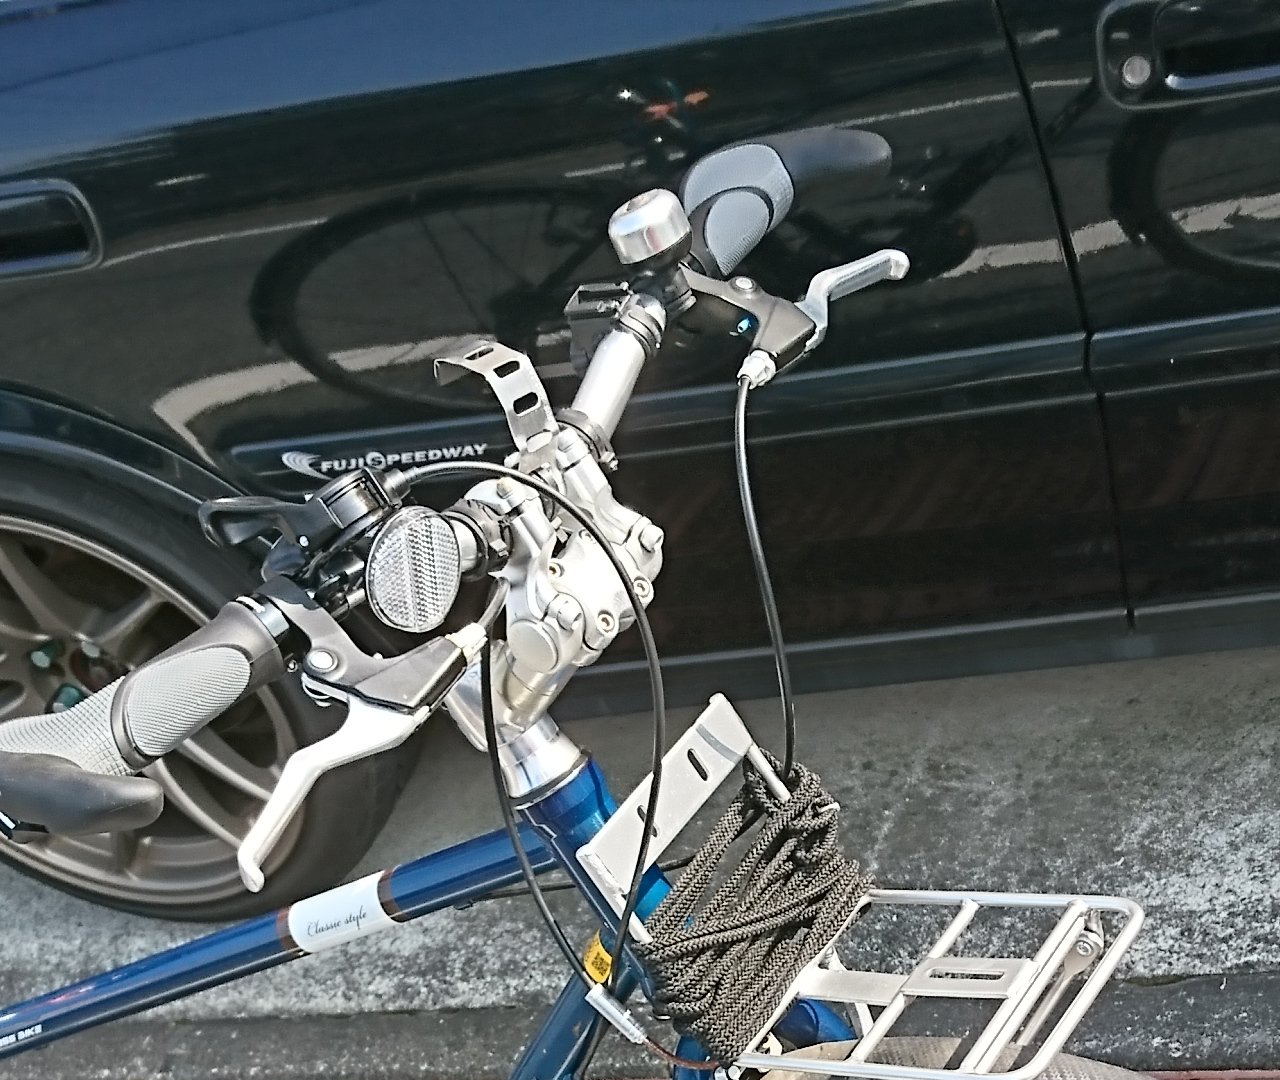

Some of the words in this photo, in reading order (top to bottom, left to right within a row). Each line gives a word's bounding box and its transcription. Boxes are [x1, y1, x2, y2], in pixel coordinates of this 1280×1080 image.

[307, 919, 341, 937] Classic
[344, 904, 367, 931] style
[17, 1024, 42, 1041] BIKE
